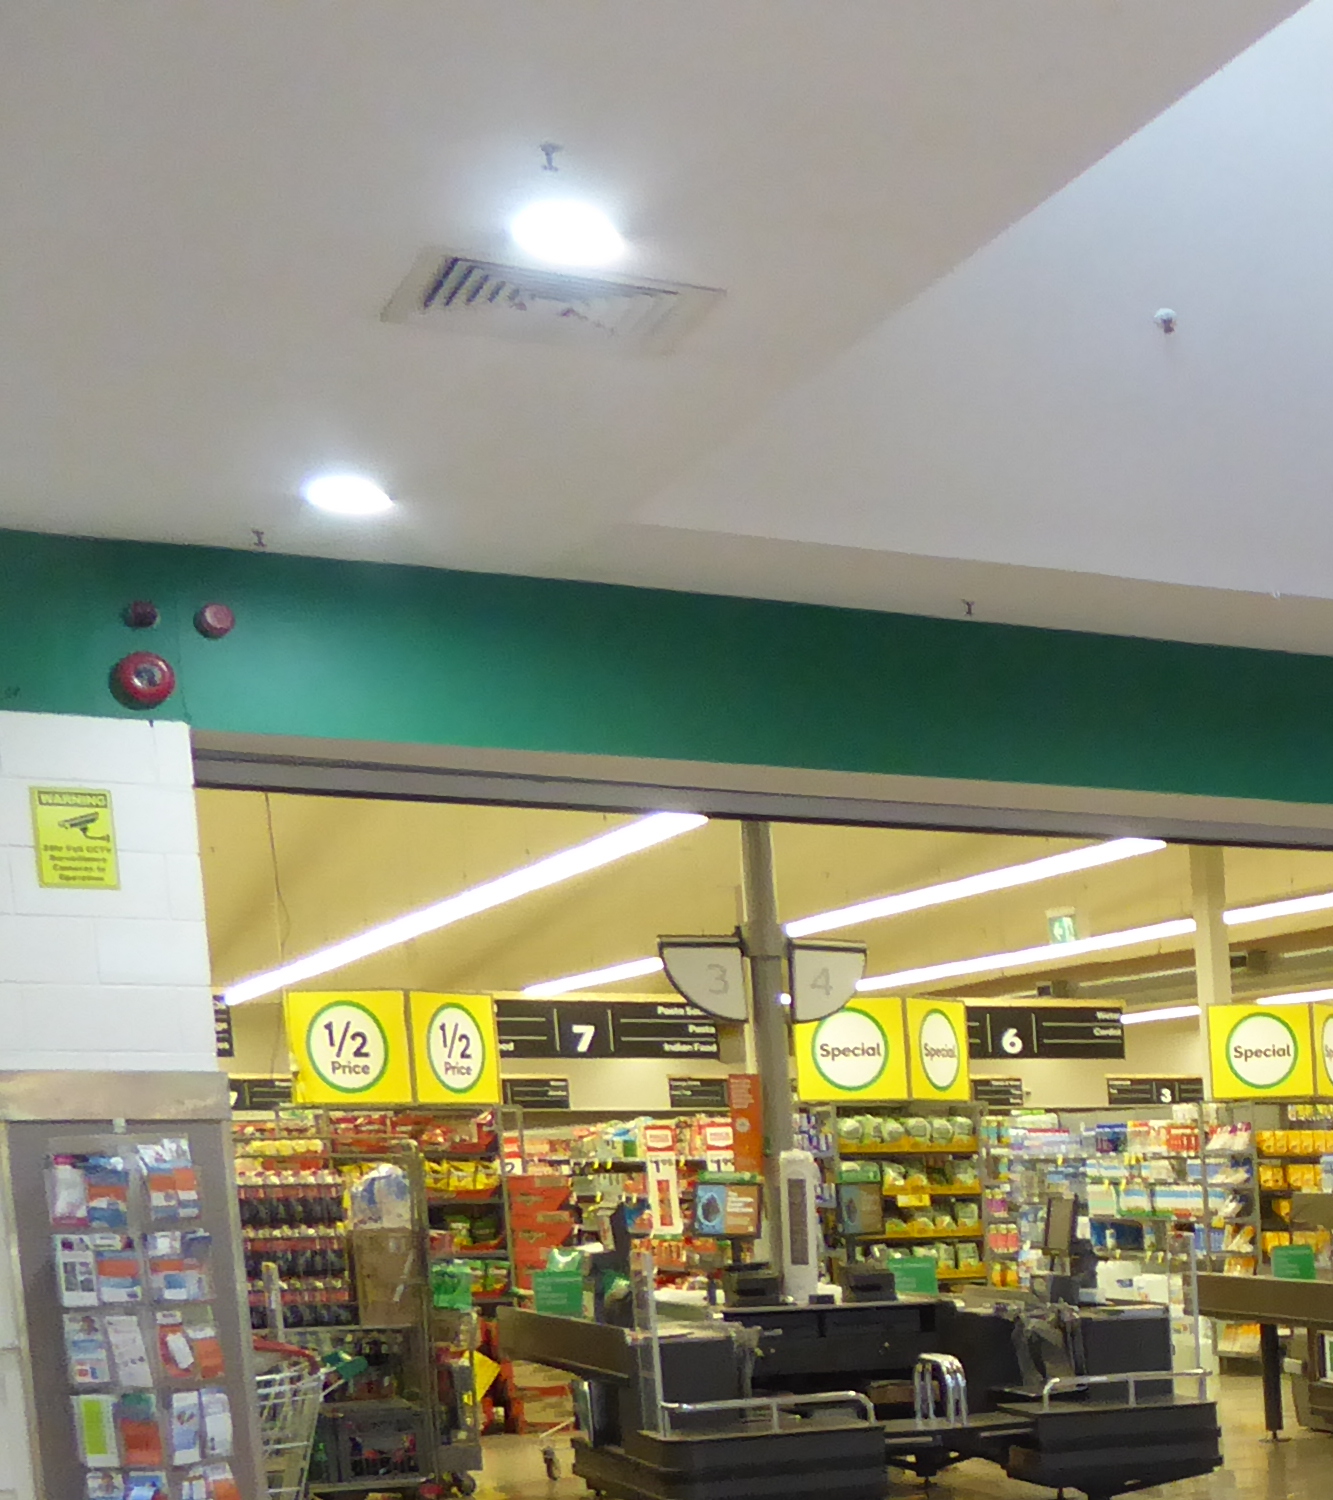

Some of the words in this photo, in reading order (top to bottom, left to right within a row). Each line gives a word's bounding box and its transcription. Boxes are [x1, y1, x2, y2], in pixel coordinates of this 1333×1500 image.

[40, 794, 106, 806] WARNING
[707, 963, 728, 994] 3
[810, 967, 833, 996] 4
[323, 1021, 371, 1058] 1/2
[439, 1022, 472, 1060] 1/2
[572, 1025, 595, 1052] 7
[1002, 1028, 1023, 1054] 6
[819, 1042, 882, 1062] Special
[923, 1042, 957, 1062] Special
[1234, 1044, 1291, 1061] Special
[331, 1061, 370, 1076] Price
[444, 1061, 473, 1076] Price
[1160, 1088, 1172, 1103] 3
